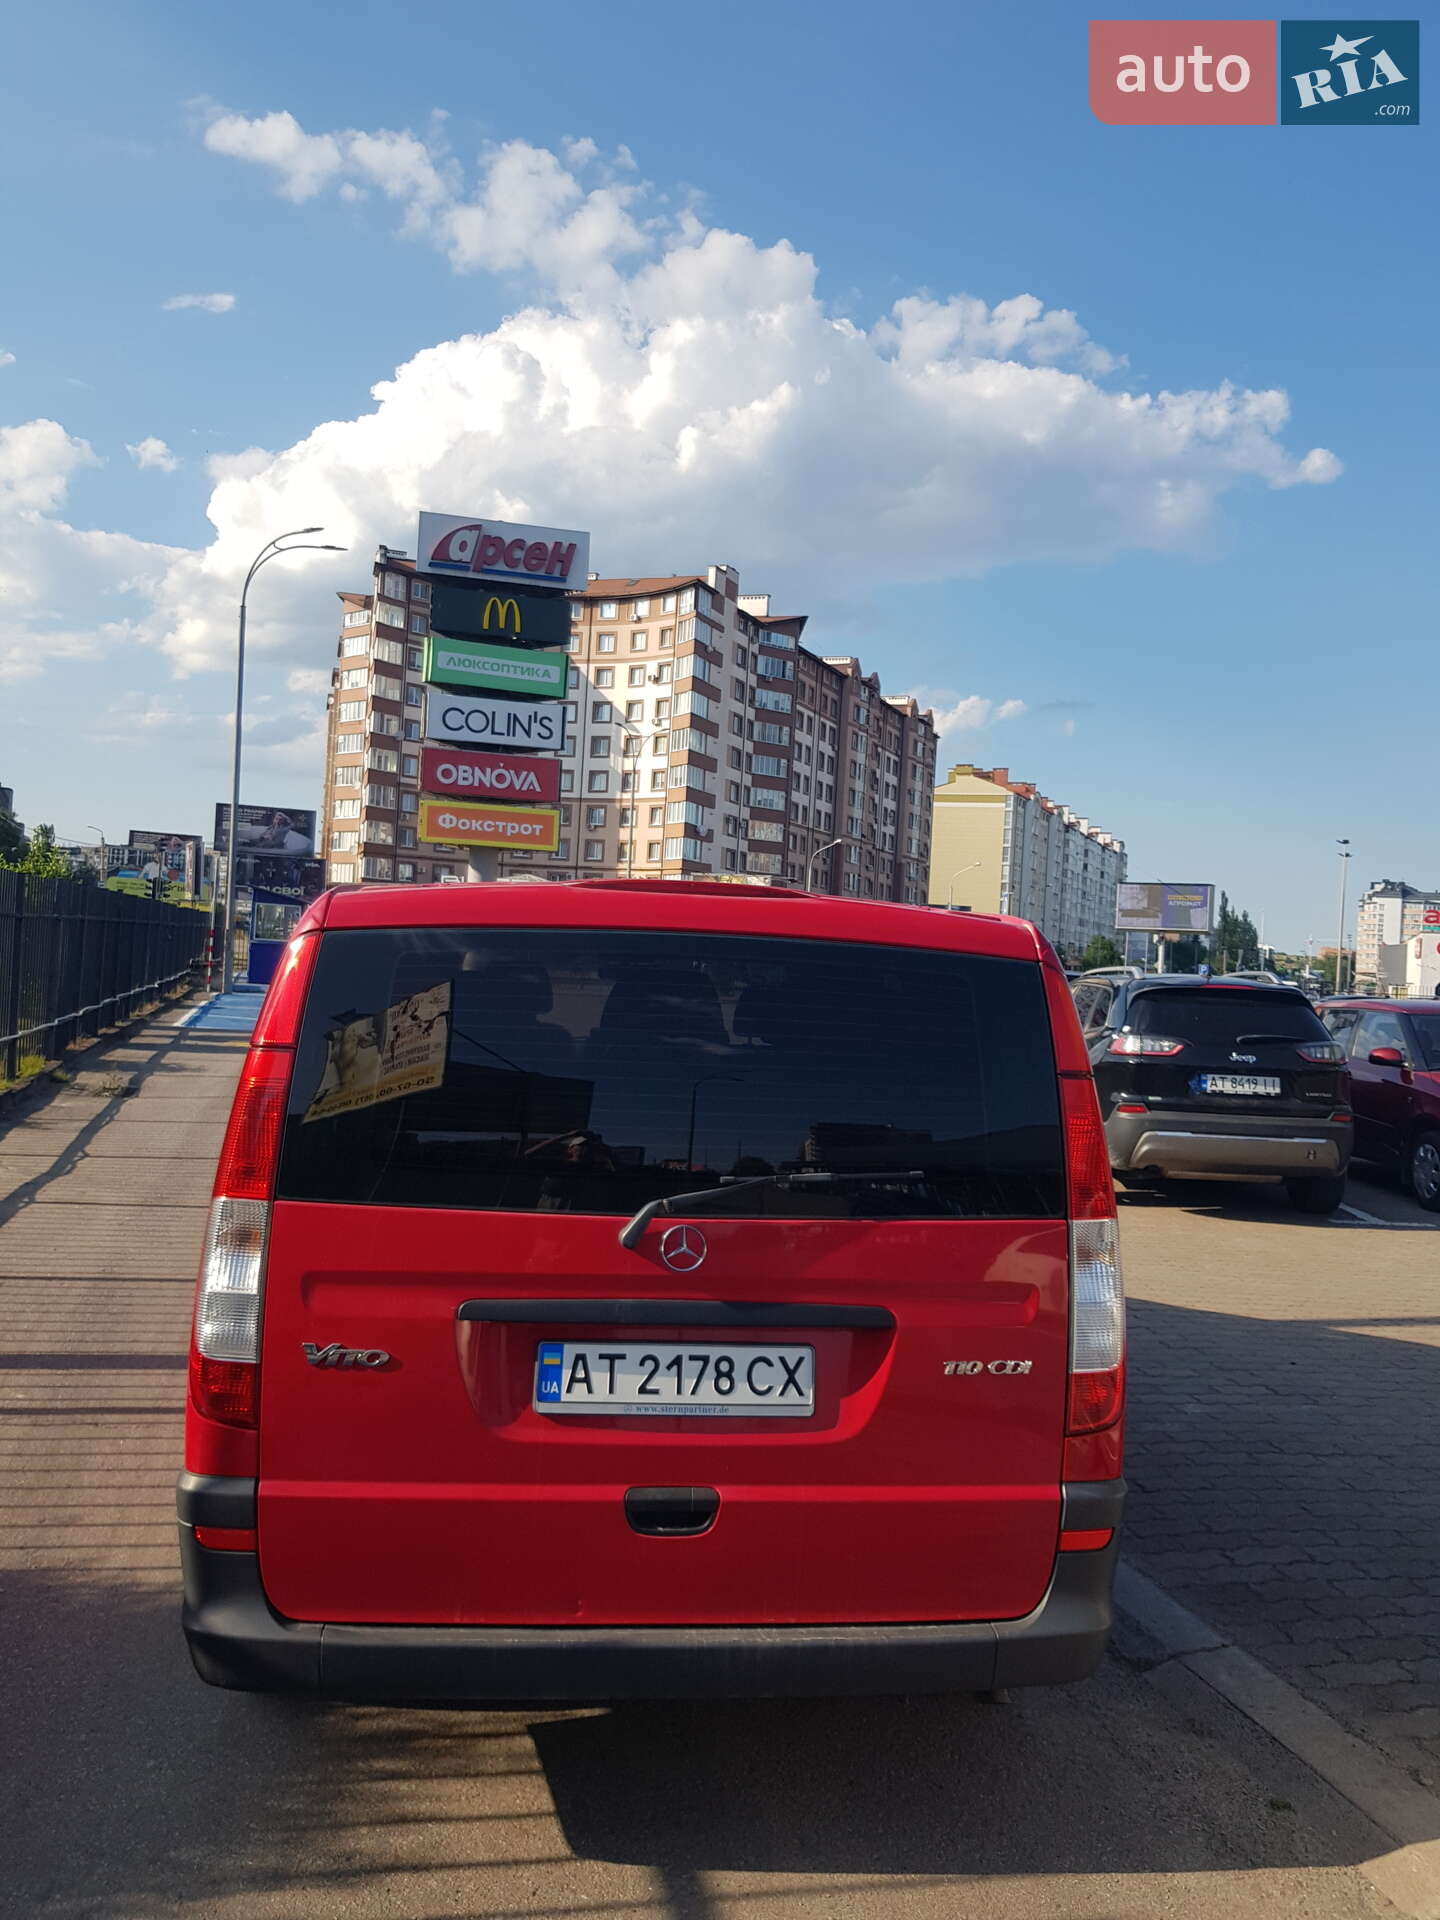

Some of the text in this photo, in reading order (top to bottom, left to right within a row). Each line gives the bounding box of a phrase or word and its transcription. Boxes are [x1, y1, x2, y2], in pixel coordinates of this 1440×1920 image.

[446, 655, 552, 679] ЛЮКСОПТИКА
[441, 706, 554, 740] COLIN'S
[437, 812, 544, 836] Фокстрот
[1228, 1051, 1257, 1064] Jeep
[1209, 1075, 1227, 1089] AT
[565, 1353, 805, 1397] AT 2178 CX
[542, 1381, 560, 1394] UA
